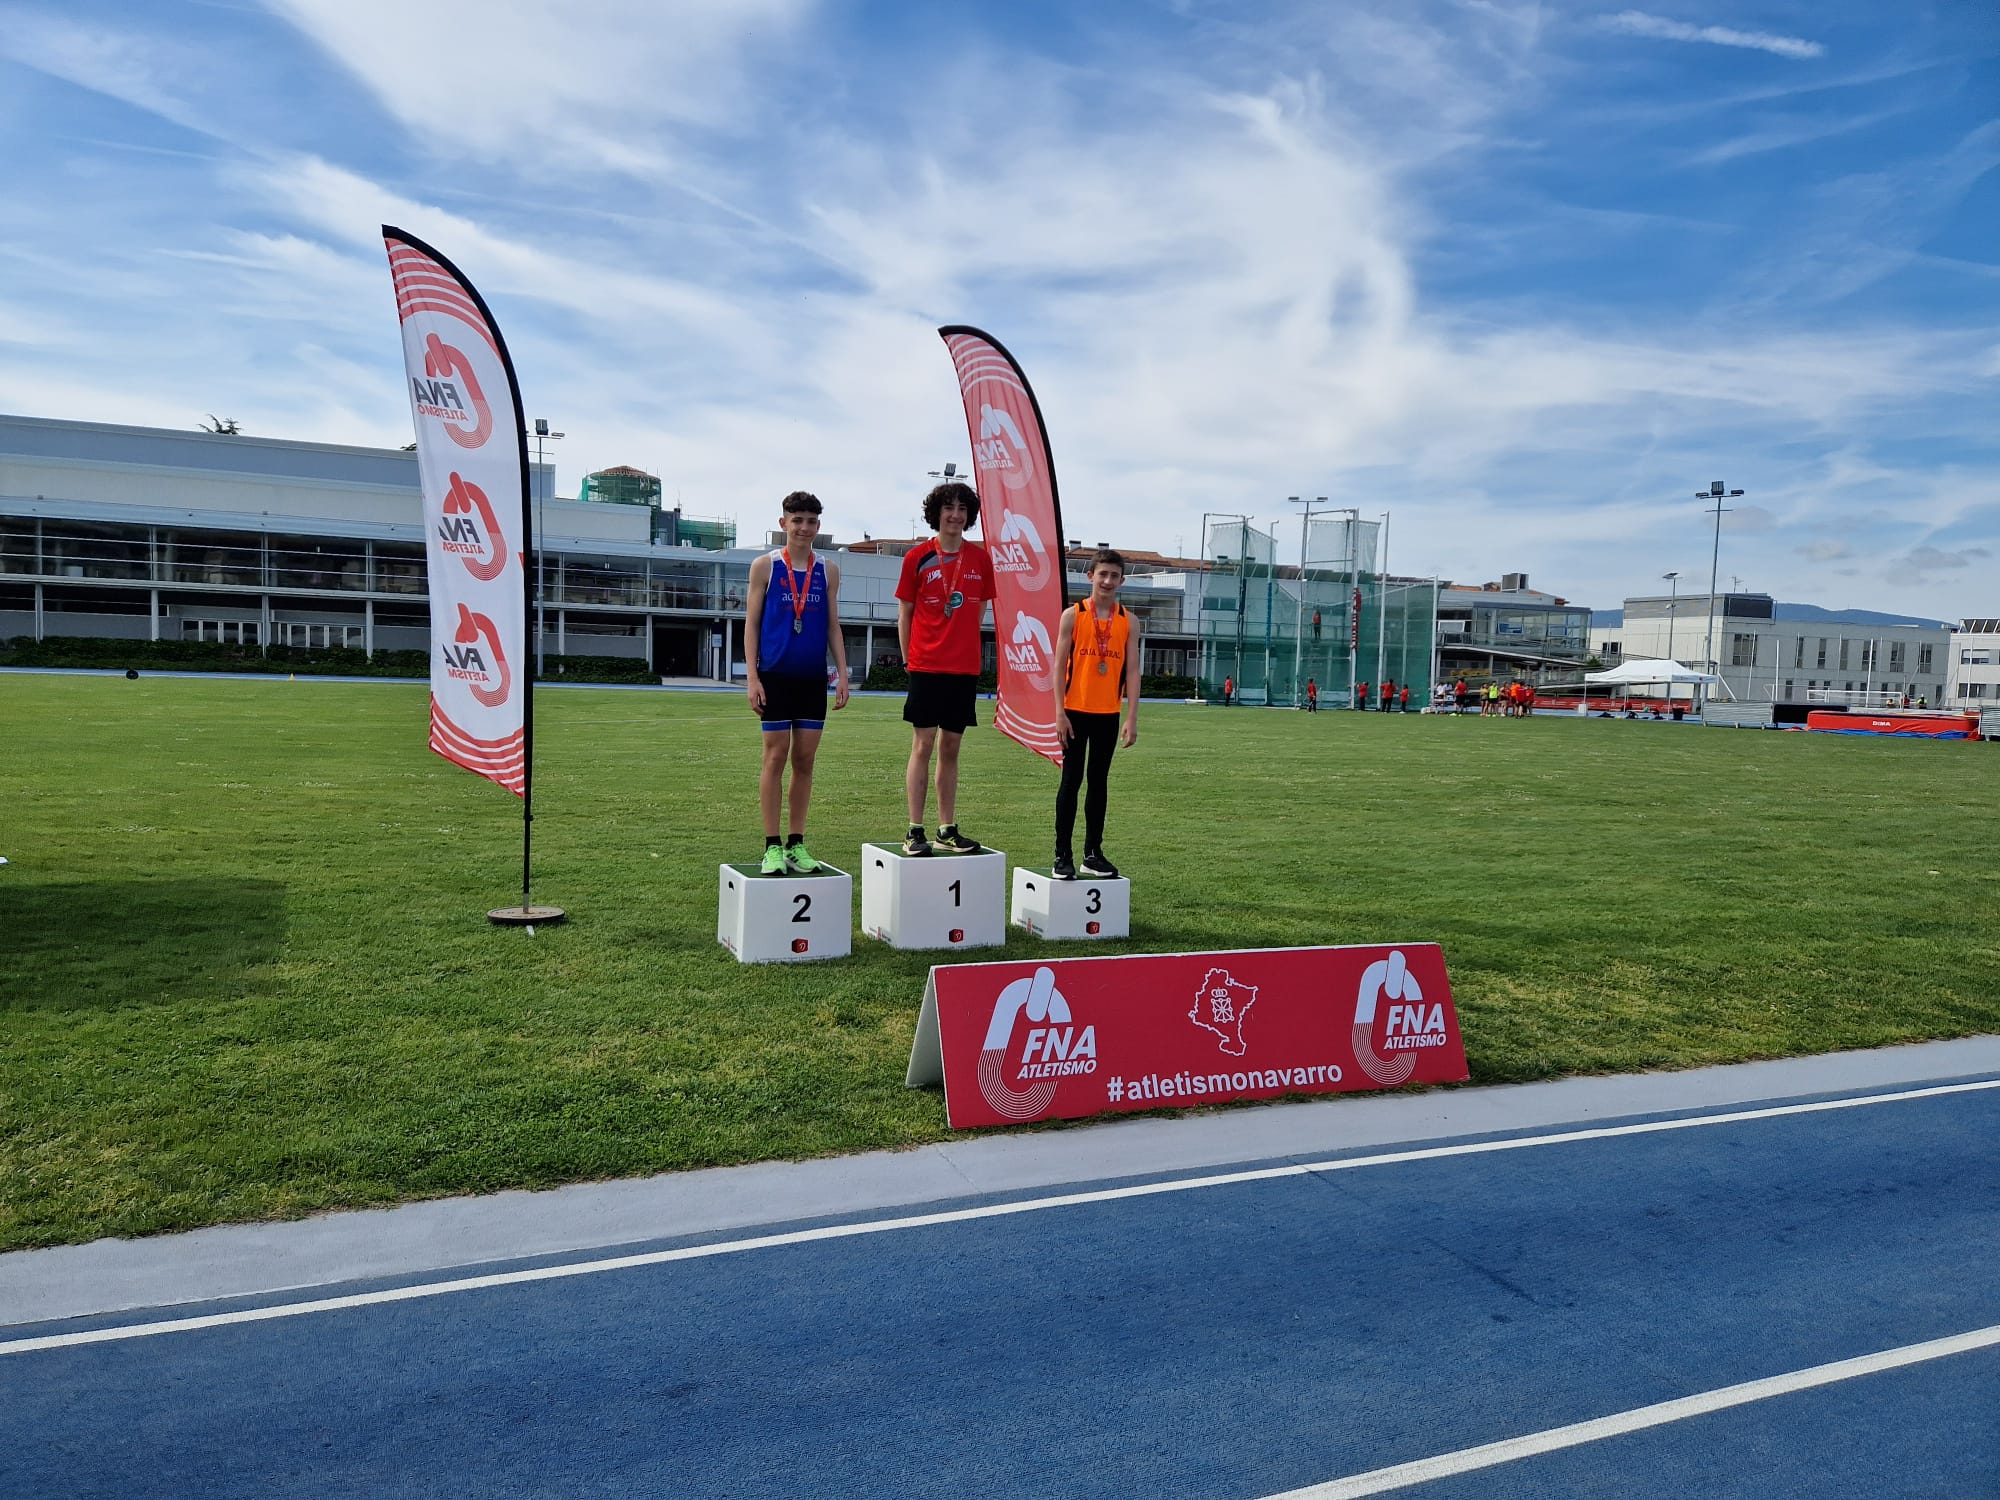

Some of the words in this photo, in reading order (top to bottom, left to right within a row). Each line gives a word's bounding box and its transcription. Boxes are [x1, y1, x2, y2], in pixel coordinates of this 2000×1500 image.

[791, 893, 812, 923] 2
[948, 879, 961, 908] 1
[1085, 888, 1102, 914] 3
[1386, 1003, 1446, 1036] FNA
[1021, 1025, 1097, 1064] FNA
[1383, 1033, 1447, 1050] ATLETISMO
[1016, 1059, 1097, 1080] ATLETISMO
[1106, 1064, 1343, 1103] #atletismonavarro
